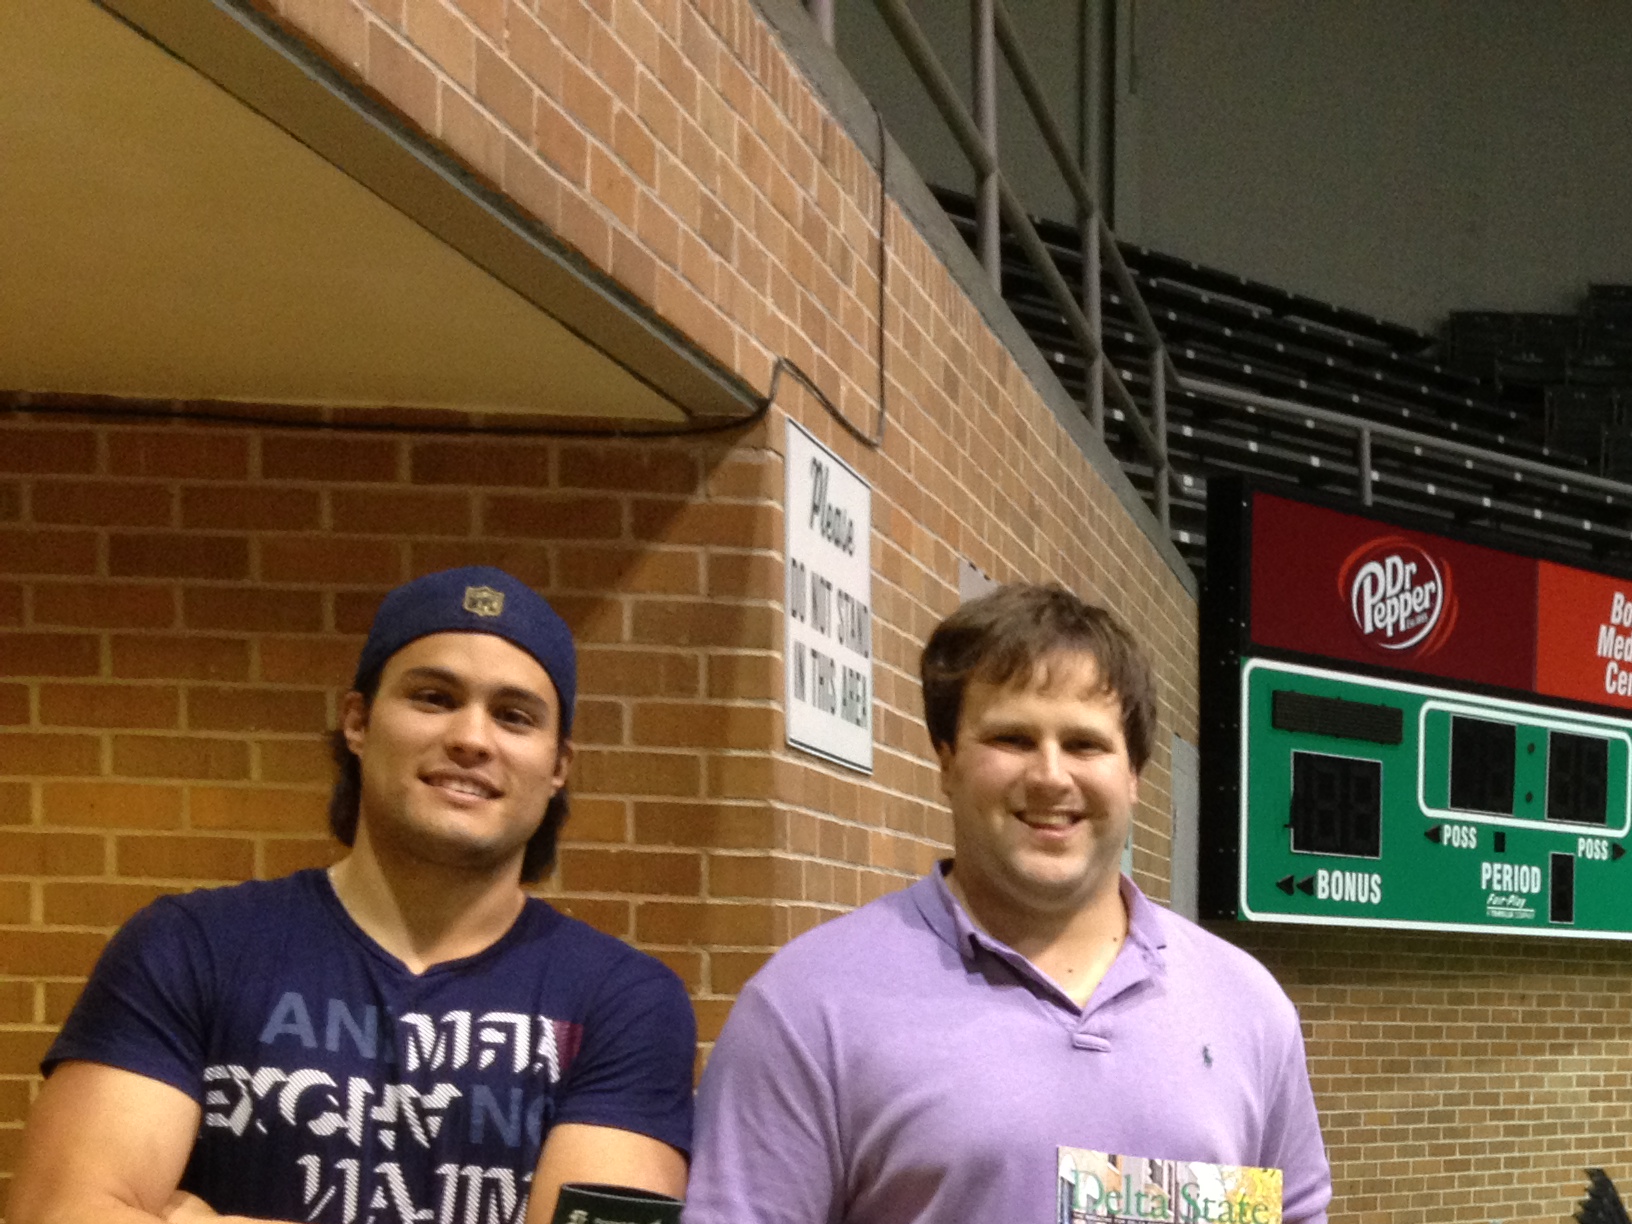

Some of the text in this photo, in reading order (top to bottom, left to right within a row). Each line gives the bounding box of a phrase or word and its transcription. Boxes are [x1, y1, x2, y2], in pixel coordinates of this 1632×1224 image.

[791, 557, 806, 624] DO
[811, 570, 832, 639] NOT
[1385, 555, 1417, 598] Dr
[1351, 561, 1436, 638] Pepper
[794, 639, 868, 731] IN THIS AREA
[1442, 824, 1478, 849] POSS
[1577, 837, 1610, 861] POSS
[1316, 868, 1383, 904] BONUS
[1481, 862, 1542, 894] PERIOD
[1071, 1168, 1170, 1220] Delta
